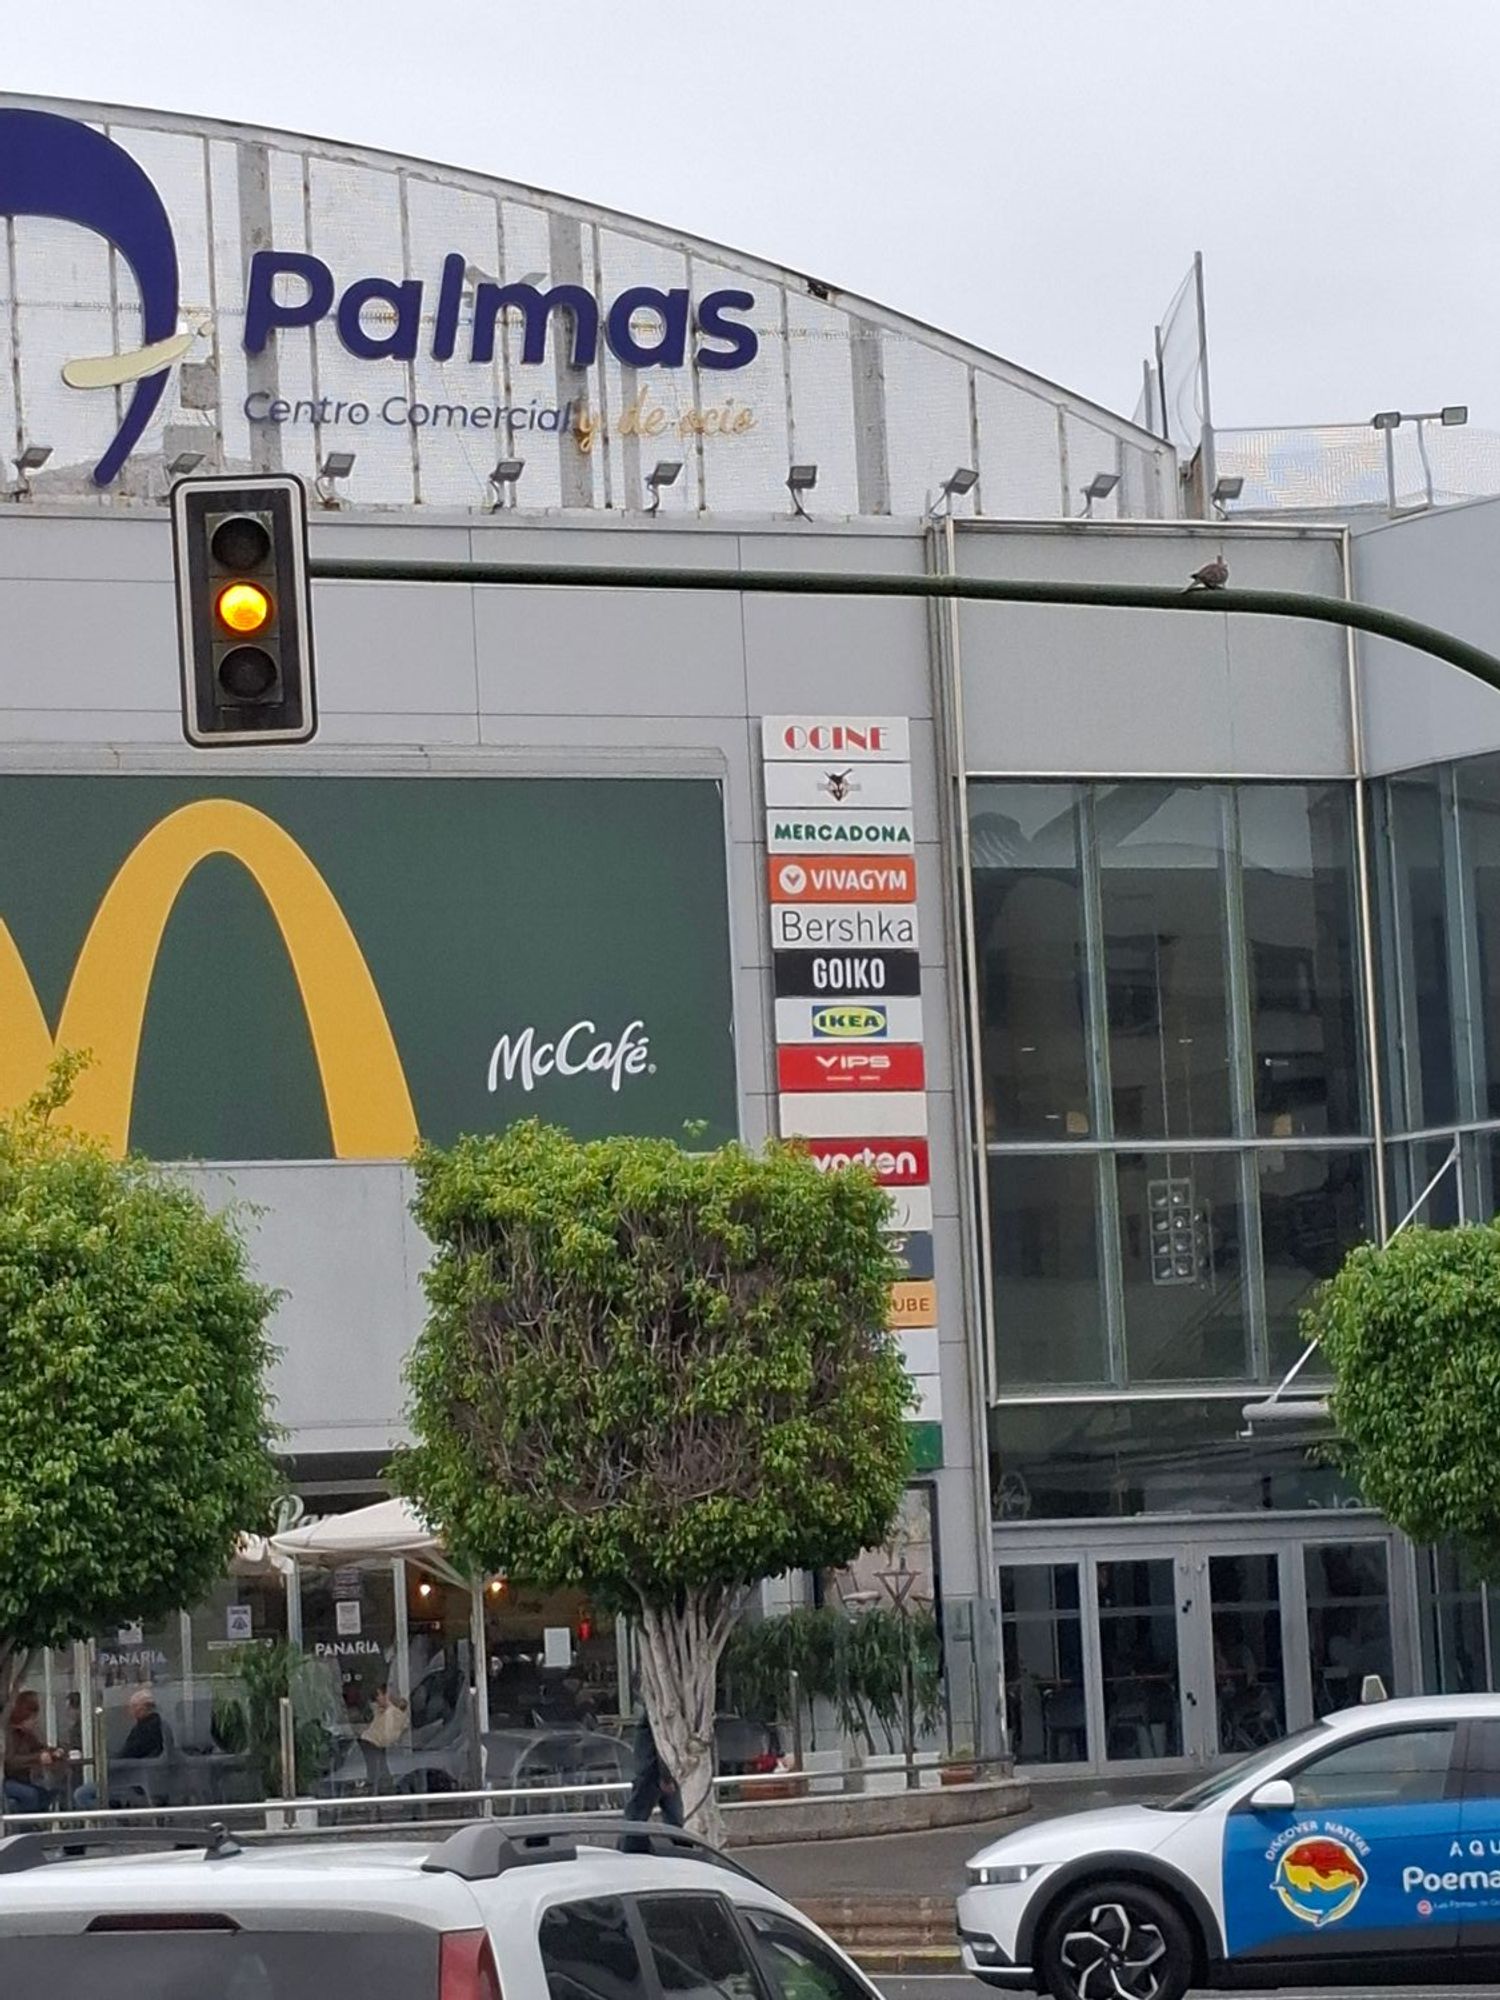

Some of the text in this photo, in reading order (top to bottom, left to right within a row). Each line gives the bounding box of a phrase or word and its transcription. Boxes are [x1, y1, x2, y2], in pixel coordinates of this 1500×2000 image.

[244, 251, 759, 370] Palmas
[244, 391, 370, 425] Centro
[381, 396, 571, 433] Comercial
[617, 383, 666, 438] de
[783, 725, 891, 750] OCINE
[774, 823, 911, 843] MERCADONA
[810, 868, 908, 891] VIVAGYM
[781, 910, 914, 943] Bershka
[812, 957, 886, 989] GOIKO
[818, 1013, 881, 1028] IKEA
[488, 1020, 650, 1092] McCafé
[815, 1055, 892, 1070] VIPS
[891, 1298, 931, 1312] UBE
[100, 1650, 168, 1666] PANARIA
[315, 1640, 381, 1657] PANARIA
[1264, 1820, 1372, 1861] DISCOVER NATURE
[1402, 1866, 1500, 1893] Poema
